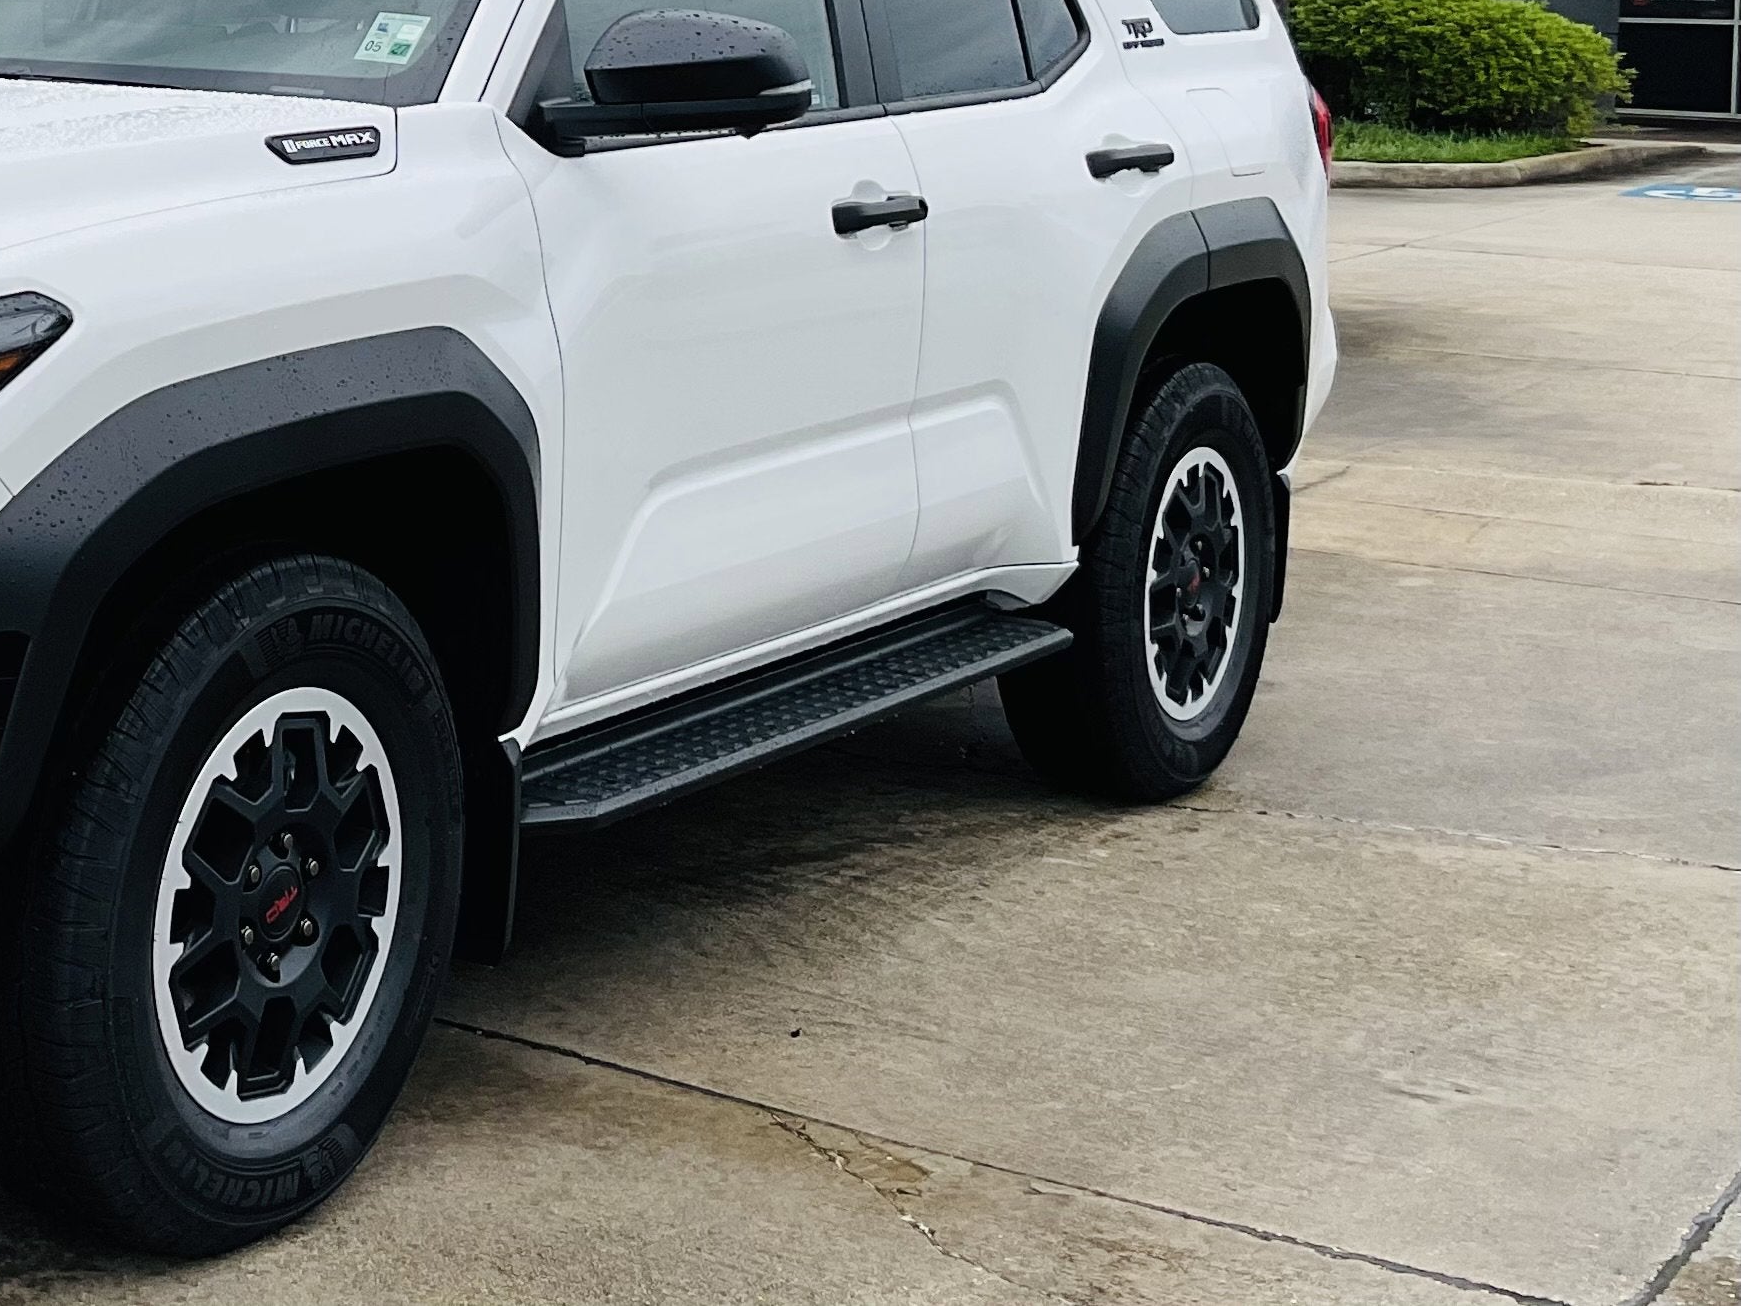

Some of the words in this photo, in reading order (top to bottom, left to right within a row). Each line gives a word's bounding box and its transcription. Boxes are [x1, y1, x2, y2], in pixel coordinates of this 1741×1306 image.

[1121, 17, 1154, 39] TRD
[364, 40, 384, 53] 05
[389, 43, 412, 56] 27
[328, 131, 376, 148] MAX
[307, 613, 427, 697] MICHELIN
